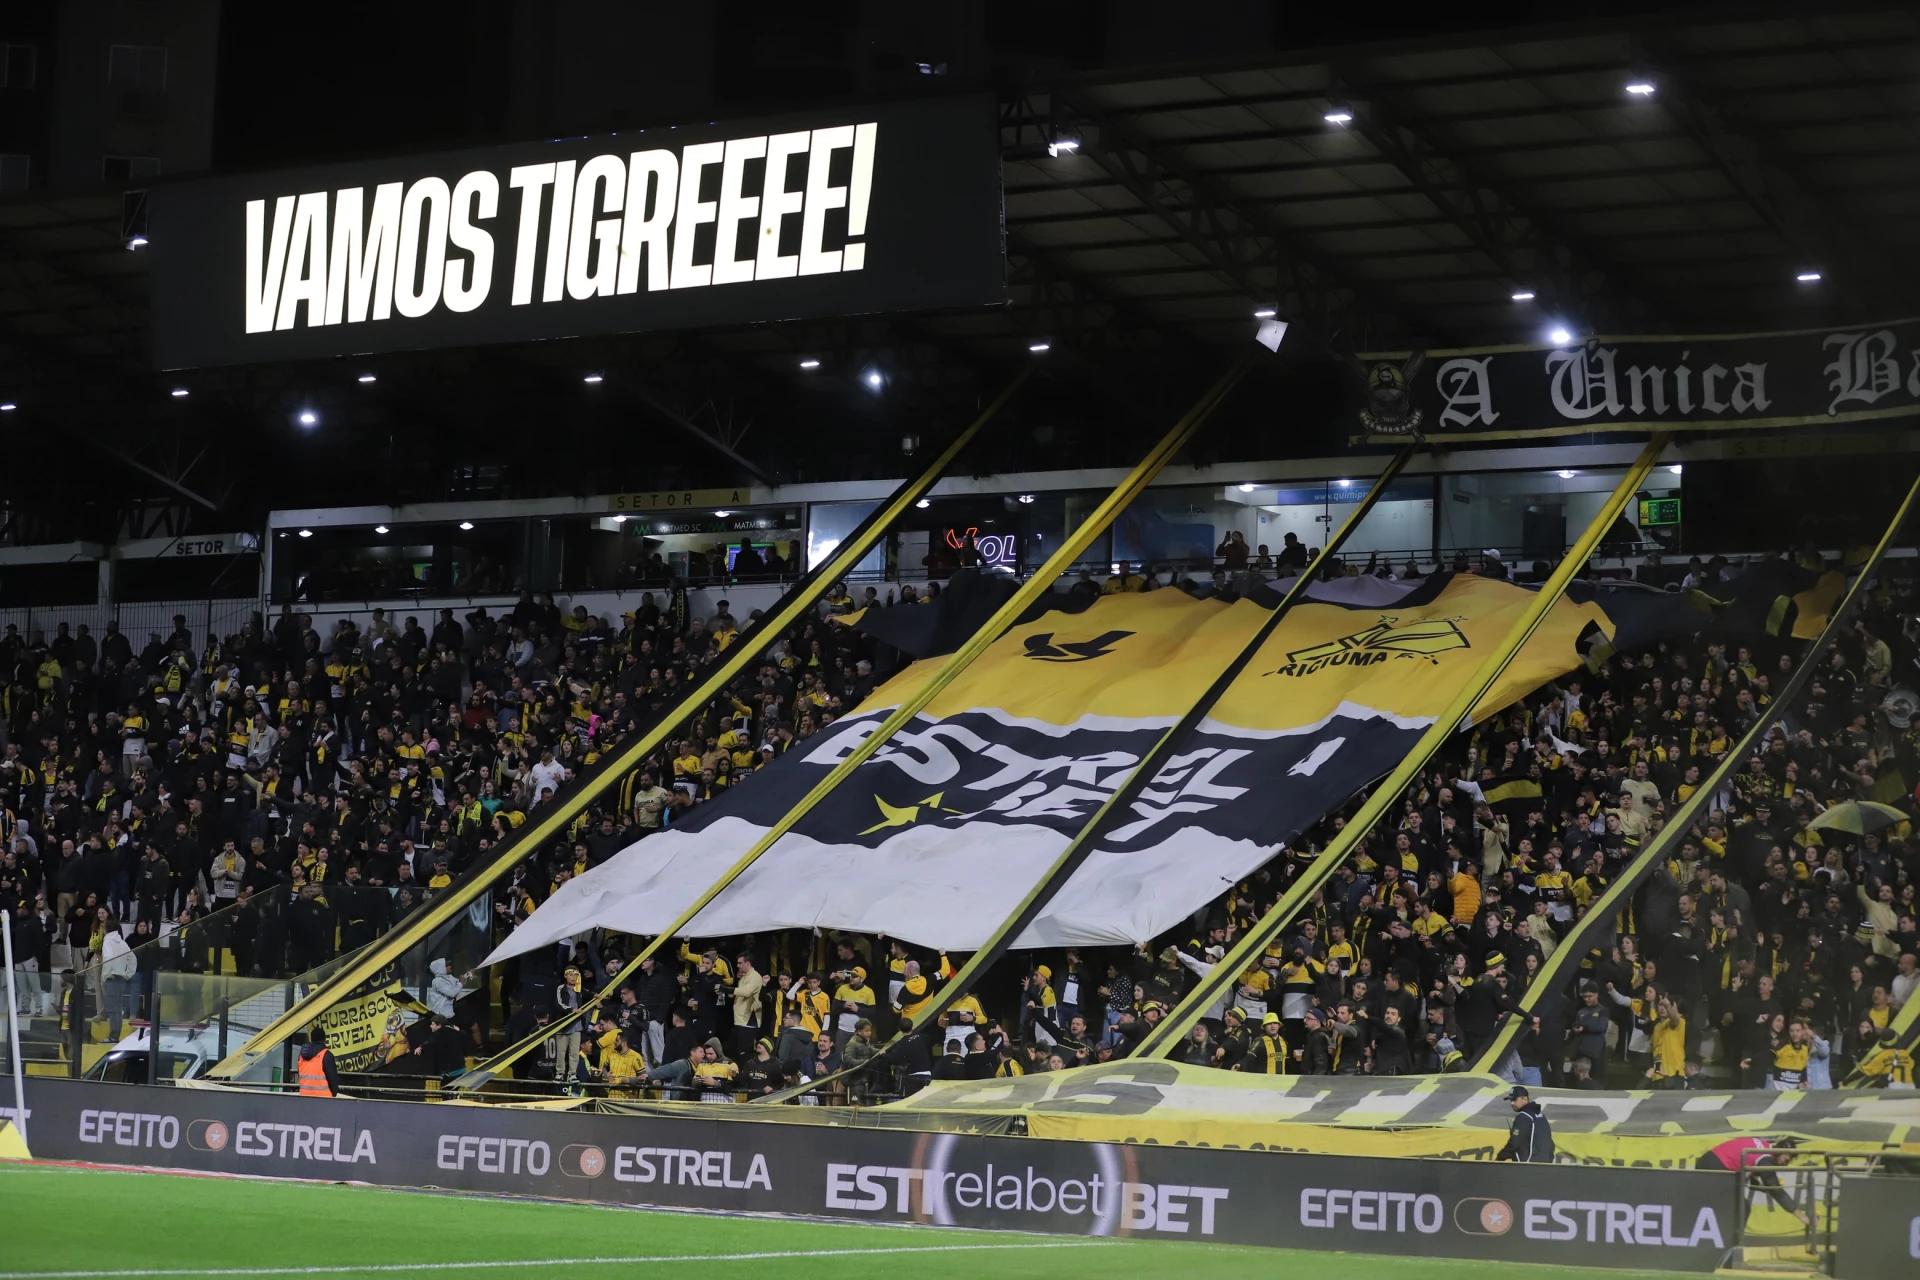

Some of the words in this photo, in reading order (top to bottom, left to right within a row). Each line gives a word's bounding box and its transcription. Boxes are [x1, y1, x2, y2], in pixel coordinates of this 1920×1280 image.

[245, 169, 500, 334] VAMOS
[510, 121, 879, 306] TIGREEEE!
[1436, 355, 1500, 428] A
[1821, 329, 1920, 417] B
[617, 492, 692, 509] SETOR
[731, 490, 740, 503] A
[176, 541, 224, 555] SETOR
[325, 1023, 376, 1050] ERVEJA
[78, 1108, 180, 1150] EFEITO
[235, 1121, 377, 1164] ESTRELA
[436, 1134, 551, 1176] EFEITO
[613, 1145, 773, 1191] ESTRELA
[938, 1163, 1106, 1217] relabet
[1119, 1181, 1230, 1235] BET
[1299, 1187, 1444, 1234] EFEITO
[1523, 1199, 1725, 1249] ESTRELA
